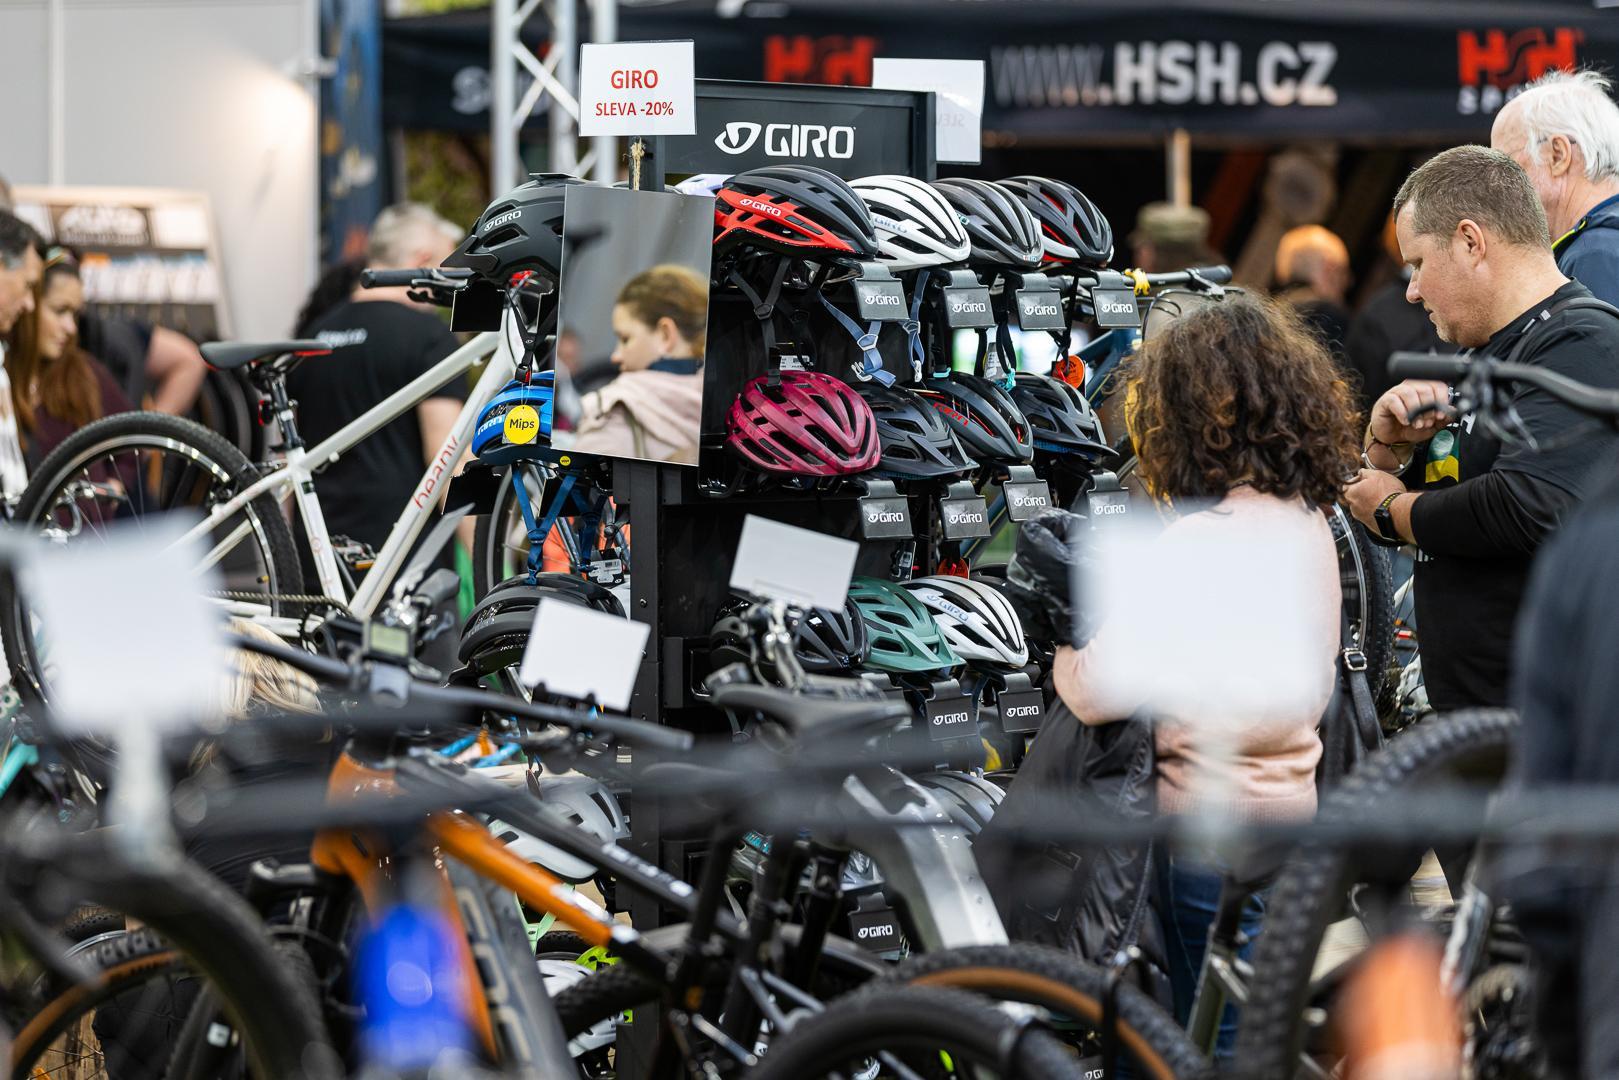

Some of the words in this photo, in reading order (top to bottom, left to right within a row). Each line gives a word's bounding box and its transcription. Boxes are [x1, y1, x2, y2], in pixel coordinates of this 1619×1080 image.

[610, 69, 659, 90] GIRO
[595, 101, 637, 117] SLEVA
[640, 101, 674, 117] -20%
[764, 123, 855, 159] GIRO
[752, 201, 782, 217] GIRO
[494, 210, 522, 226] GIRO
[875, 295, 900, 306] GIRO
[962, 302, 987, 313] GIRO
[1034, 305, 1058, 316] GIRO
[1111, 303, 1134, 314] GIRO
[509, 418, 535, 430] Mips
[1024, 496, 1047, 507] GIRO
[1104, 504, 1126, 515] GIRO
[879, 512, 904, 523] GIRO
[959, 513, 983, 524] GIRO
[1017, 705, 1040, 717] GIRO
[944, 711, 969, 725] GIRO
[868, 924, 893, 938] GIRO
